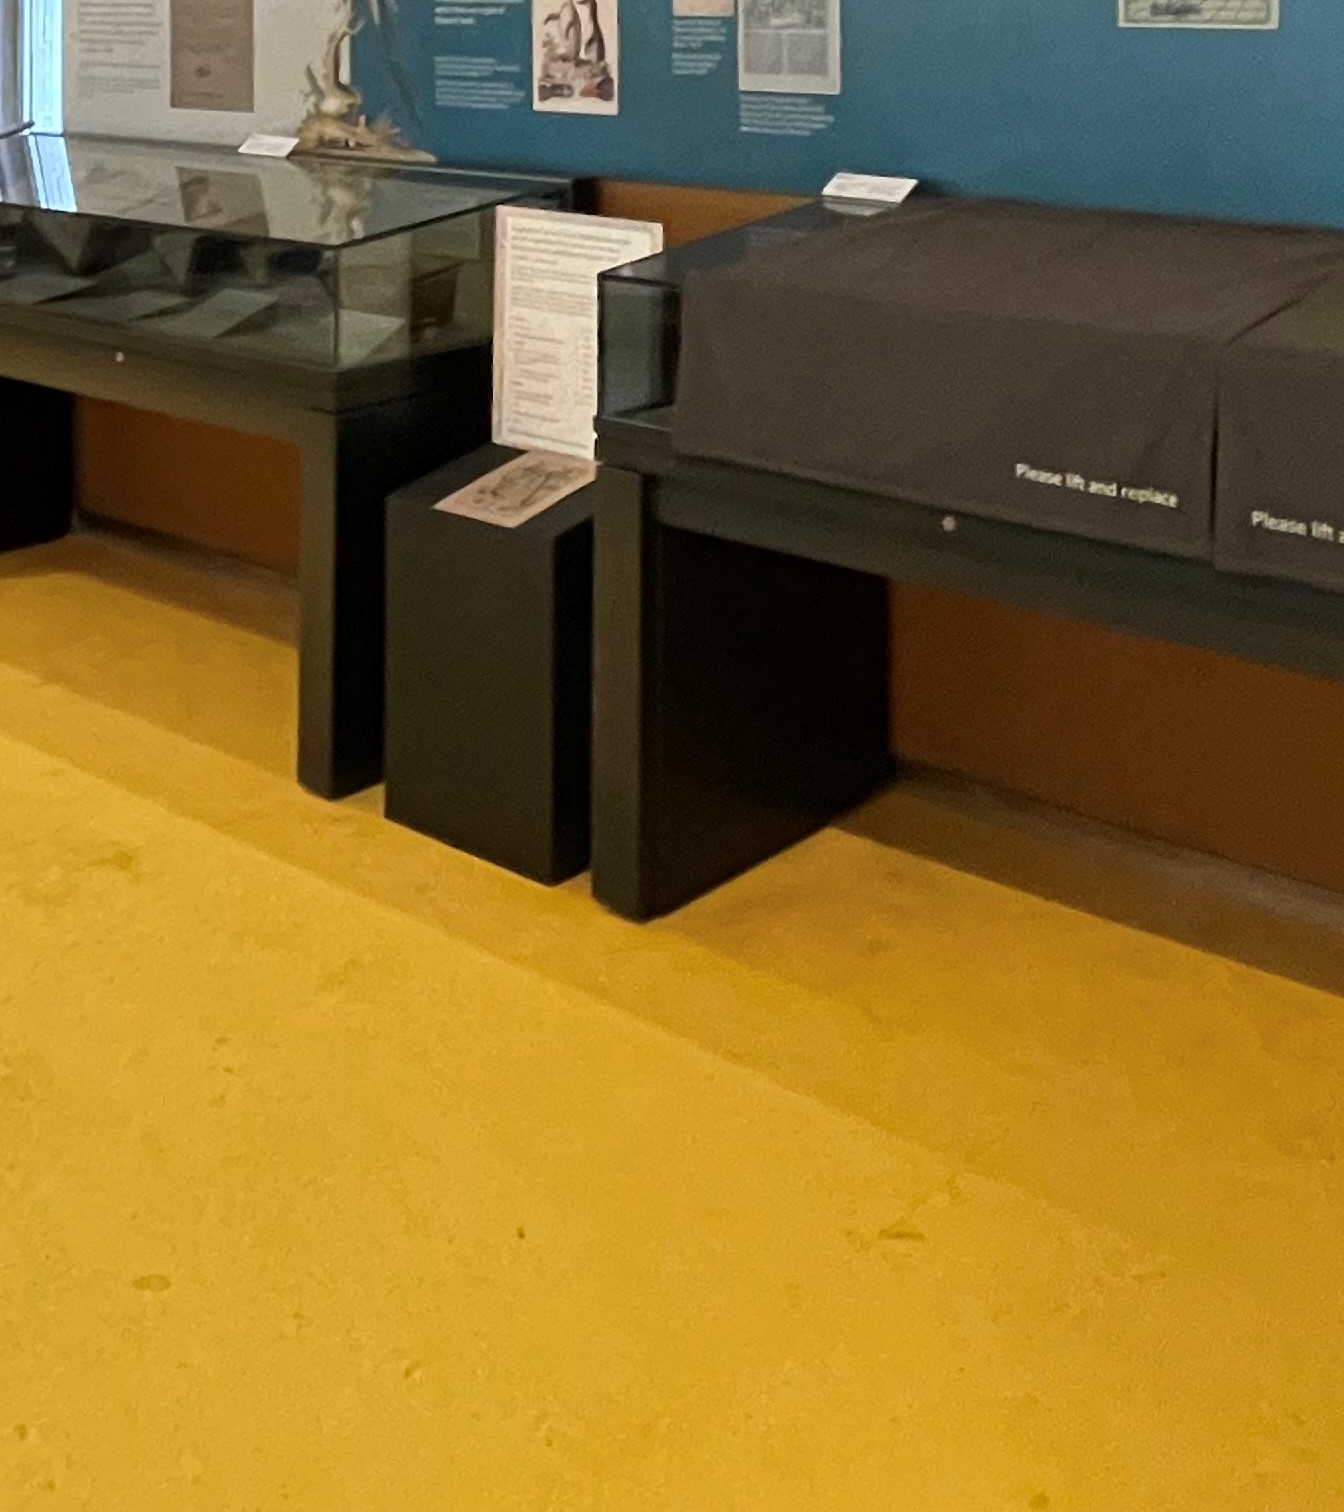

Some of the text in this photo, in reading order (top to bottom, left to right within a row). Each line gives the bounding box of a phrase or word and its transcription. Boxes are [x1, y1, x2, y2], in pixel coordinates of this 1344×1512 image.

[1015, 463, 1180, 509] Please lift and replace
[1250, 509, 1308, 537] Please
[1311, 519, 1335, 542] lift
